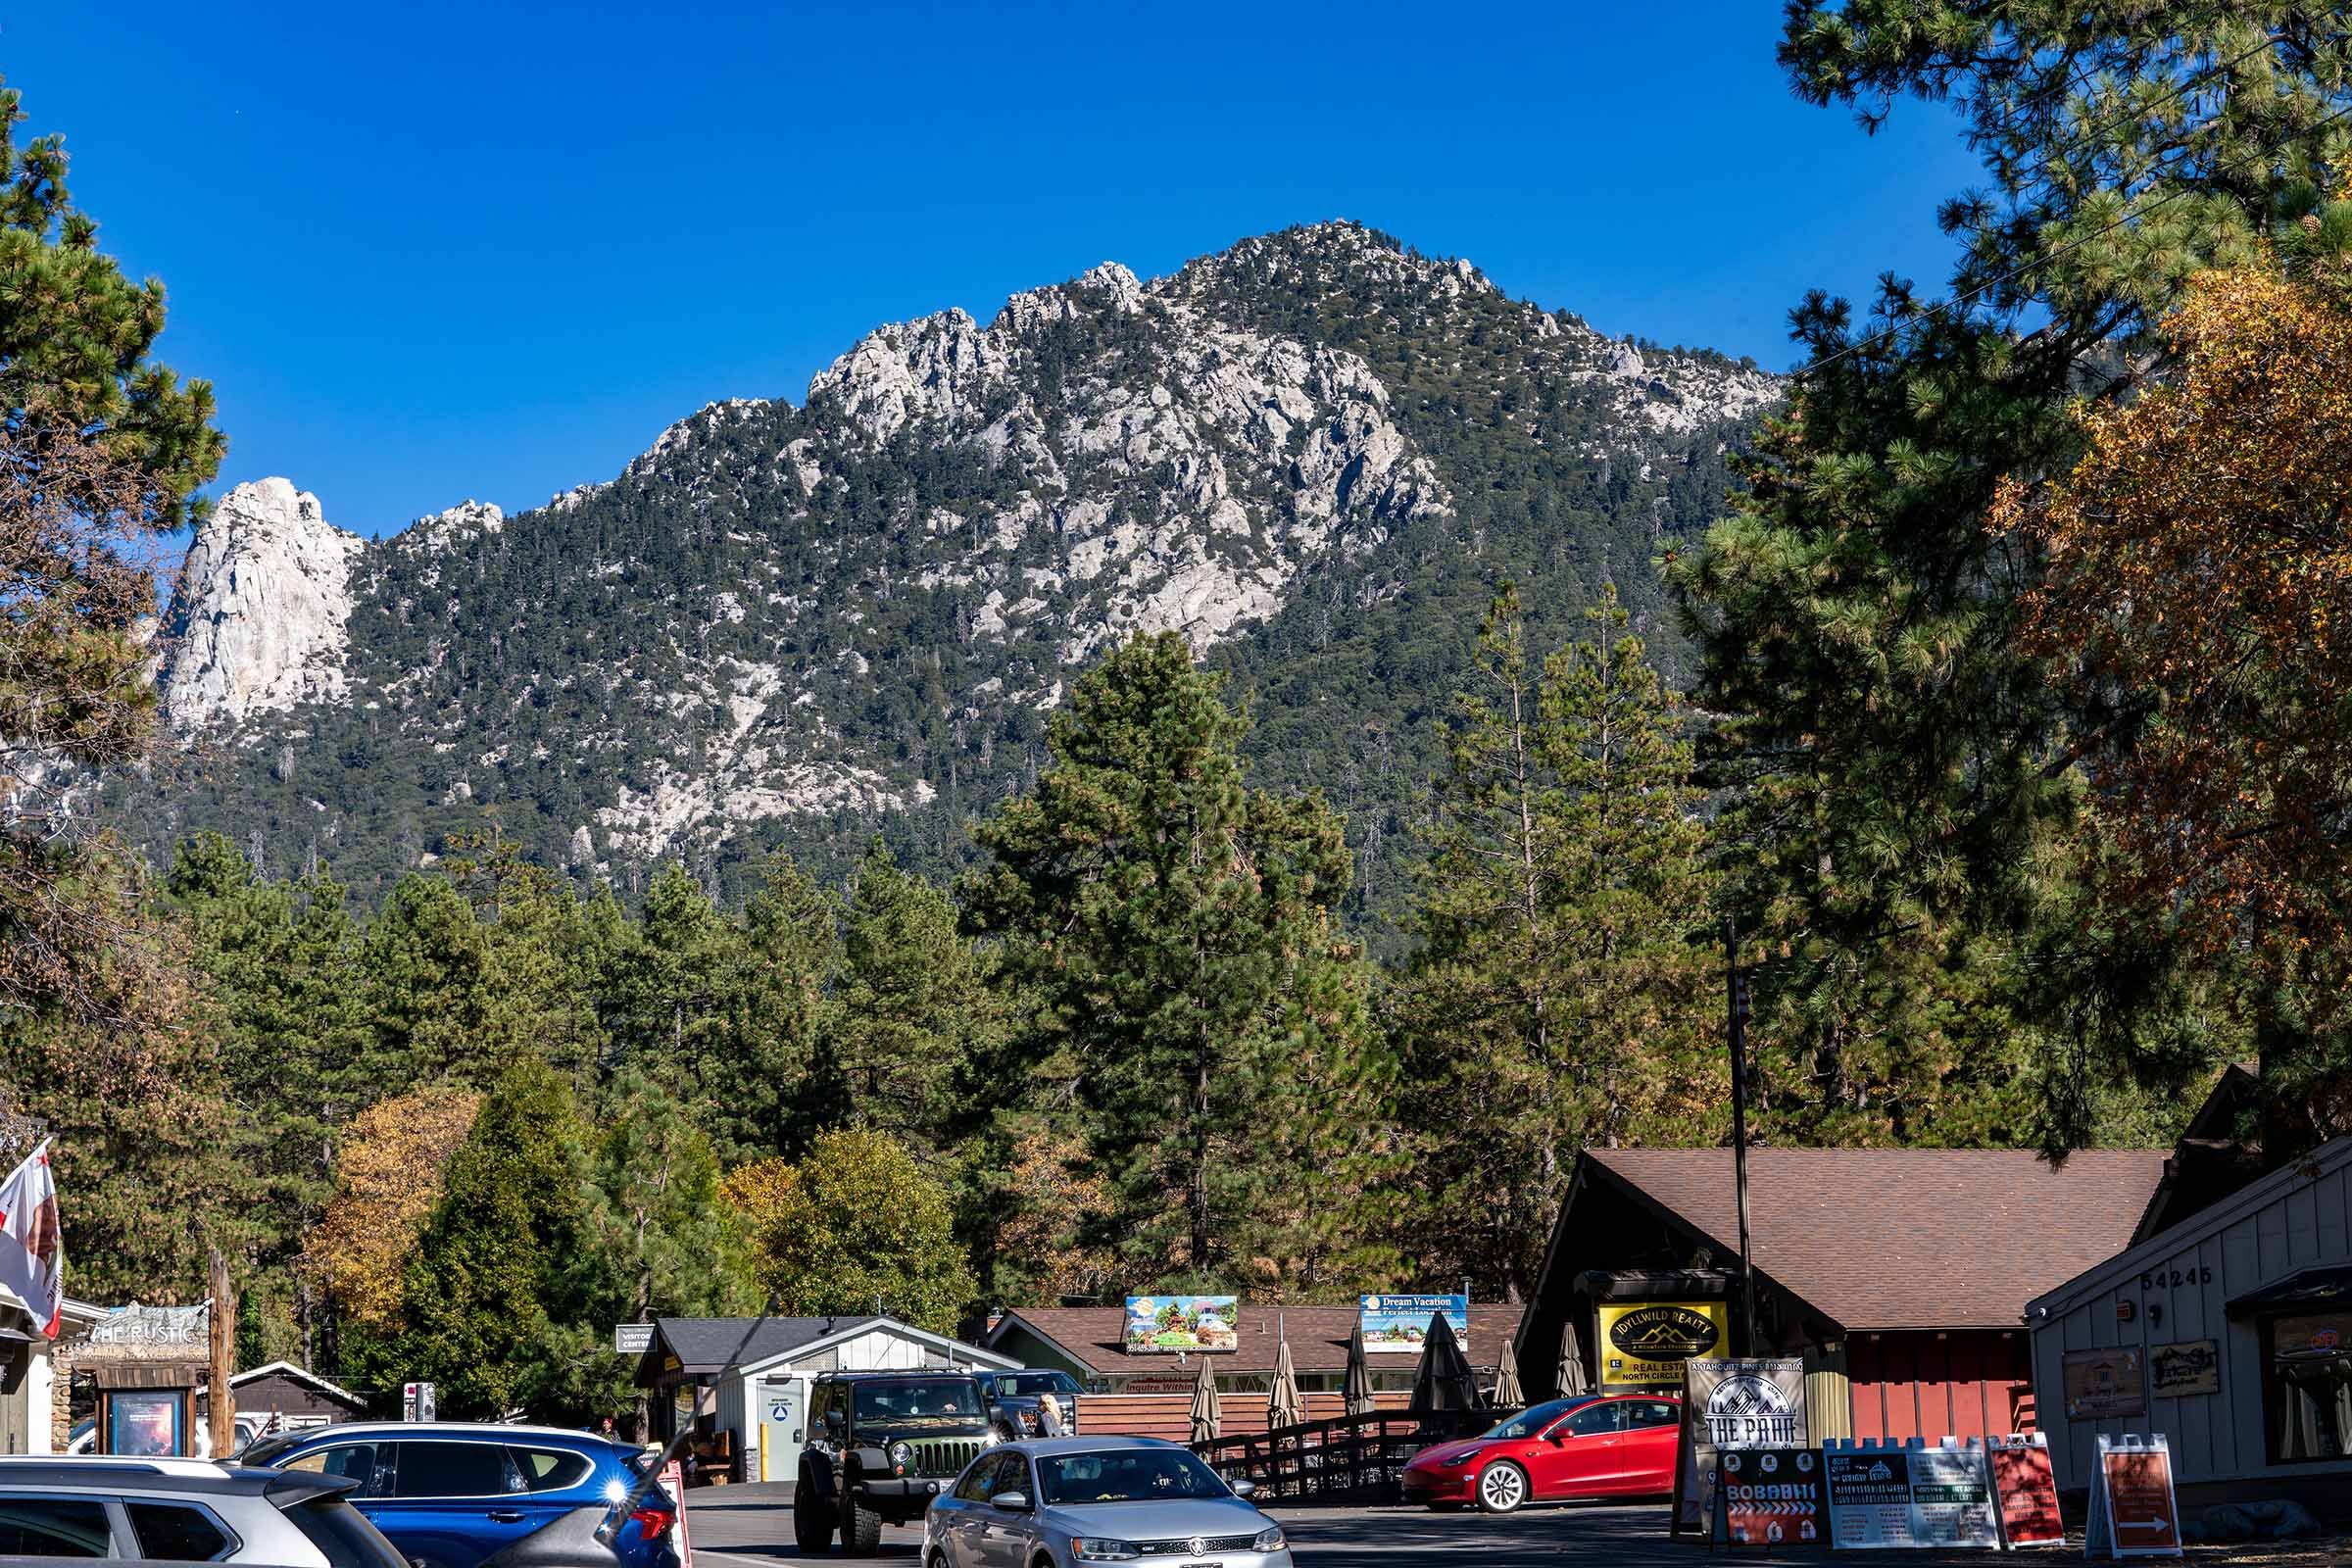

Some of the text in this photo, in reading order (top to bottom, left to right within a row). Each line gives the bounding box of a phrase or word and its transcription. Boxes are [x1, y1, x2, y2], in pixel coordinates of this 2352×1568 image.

[1383, 1297, 1451, 1306] Dream Vacation
[1383, 1306, 1412, 1316] Perfect
[1615, 1310, 1712, 1336] IDYLLWILD REALTY
[90, 1326, 195, 1344] THE RUSTIC
[1633, 1363, 1660, 1372] REAL
[1126, 1382, 1193, 1392] Inquire Within
[1705, 1418, 1739, 1444] THE
